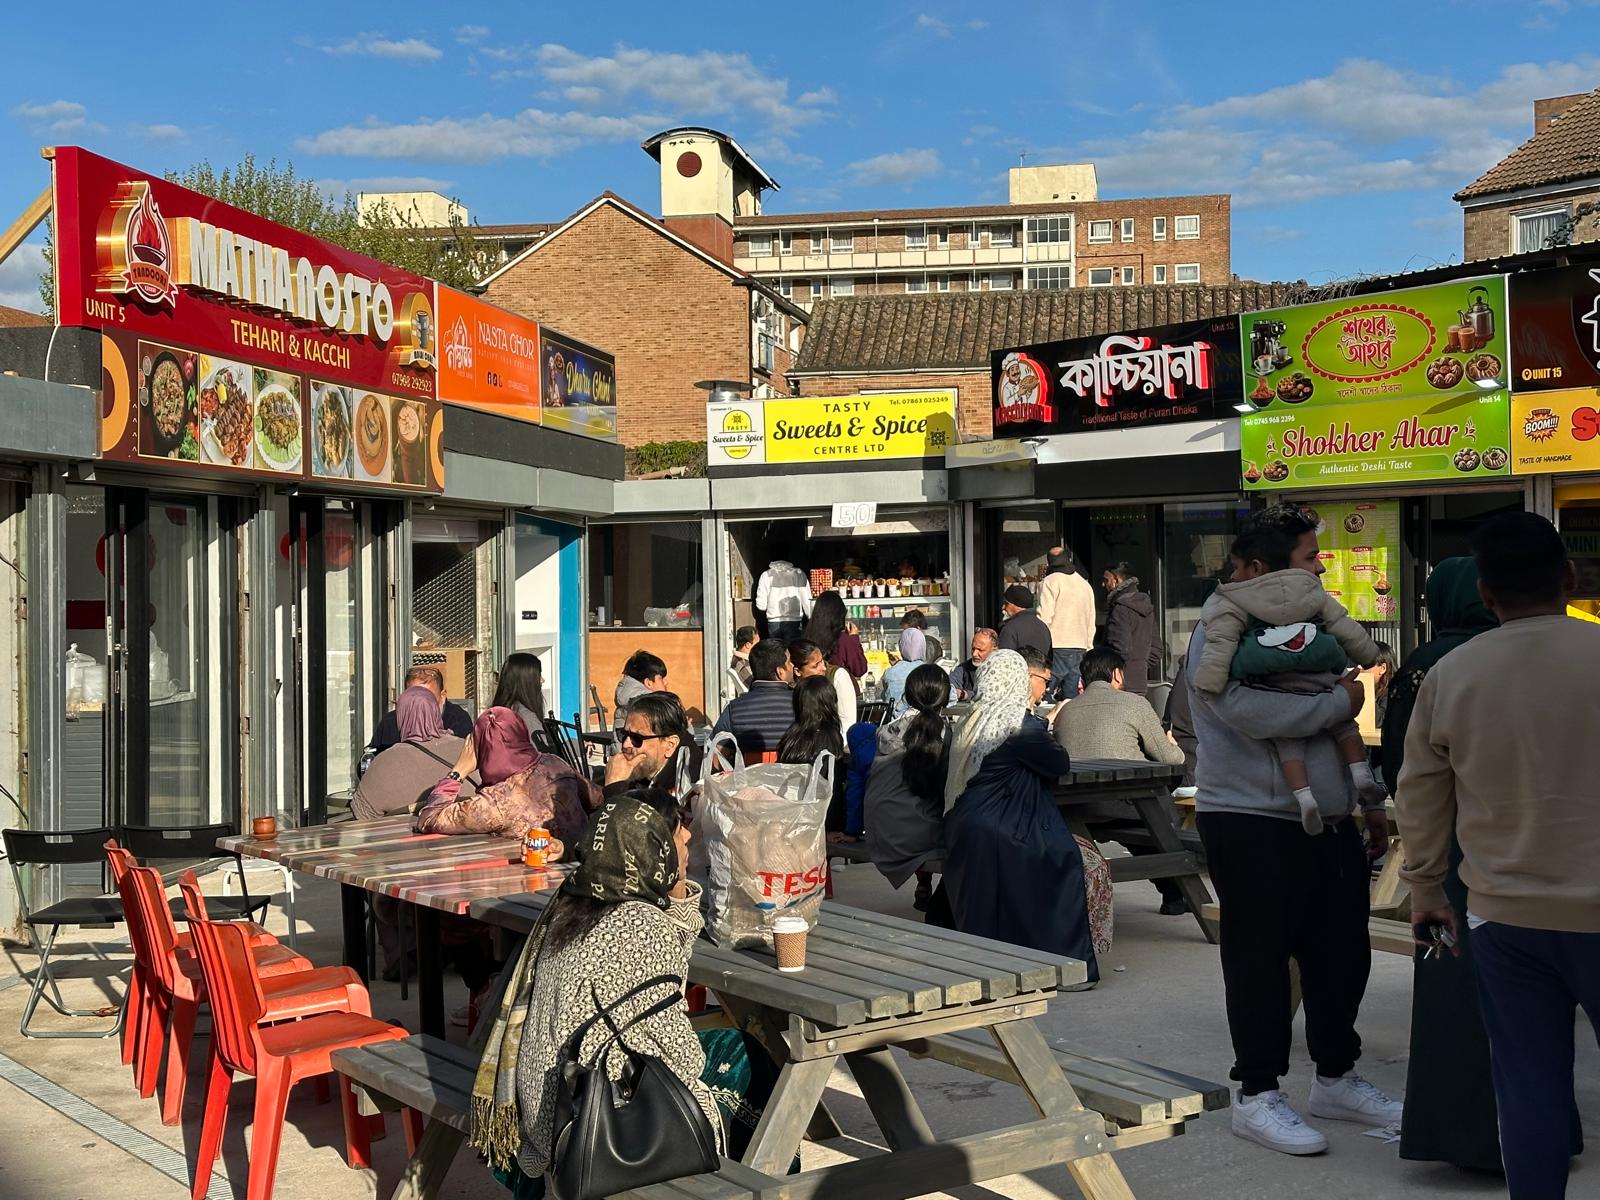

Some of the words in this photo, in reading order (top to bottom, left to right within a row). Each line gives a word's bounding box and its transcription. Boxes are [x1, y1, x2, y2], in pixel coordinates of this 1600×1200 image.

[85, 298, 116, 321] UNIT
[118, 306, 127, 323] 5
[230, 319, 285, 354] TEHARI
[288, 334, 301, 358] &
[304, 338, 350, 369] KACCHI
[478, 320, 508, 351] NASTA
[509, 332, 534, 360] GHOR
[1532, 368, 1552, 380] UNIT
[1552, 367, 1562, 378] 15
[823, 401, 871, 413] TASTY
[1479, 395, 1492, 403] Unit
[1082, 412, 1118, 425] Traditional
[1119, 410, 1138, 421] Taste
[1139, 409, 1148, 419] of
[1172, 405, 1198, 416] Dhaka
[1525, 416, 1560, 434] BOOM!!!
[1571, 406, 1600, 442] S
[773, 420, 842, 440] Sweets
[847, 417, 866, 437] &
[872, 415, 928, 441] Spice
[1281, 422, 1385, 459] Shokher
[1390, 416, 1459, 451] Ahar
[712, 435, 736, 443] Sweets
[745, 434, 764, 443] Spice
[814, 445, 859, 455] CENTRE
[864, 443, 885, 453] LTD
[1319, 463, 1359, 475] Authentic
[1361, 460, 1387, 471] Deshi
[1388, 460, 1413, 470] Taste
[1519, 457, 1535, 465] TASTE
[1543, 454, 1573, 463] HANDMADE
[592, 803, 616, 852] PARIS
[622, 848, 640, 895] PARI
